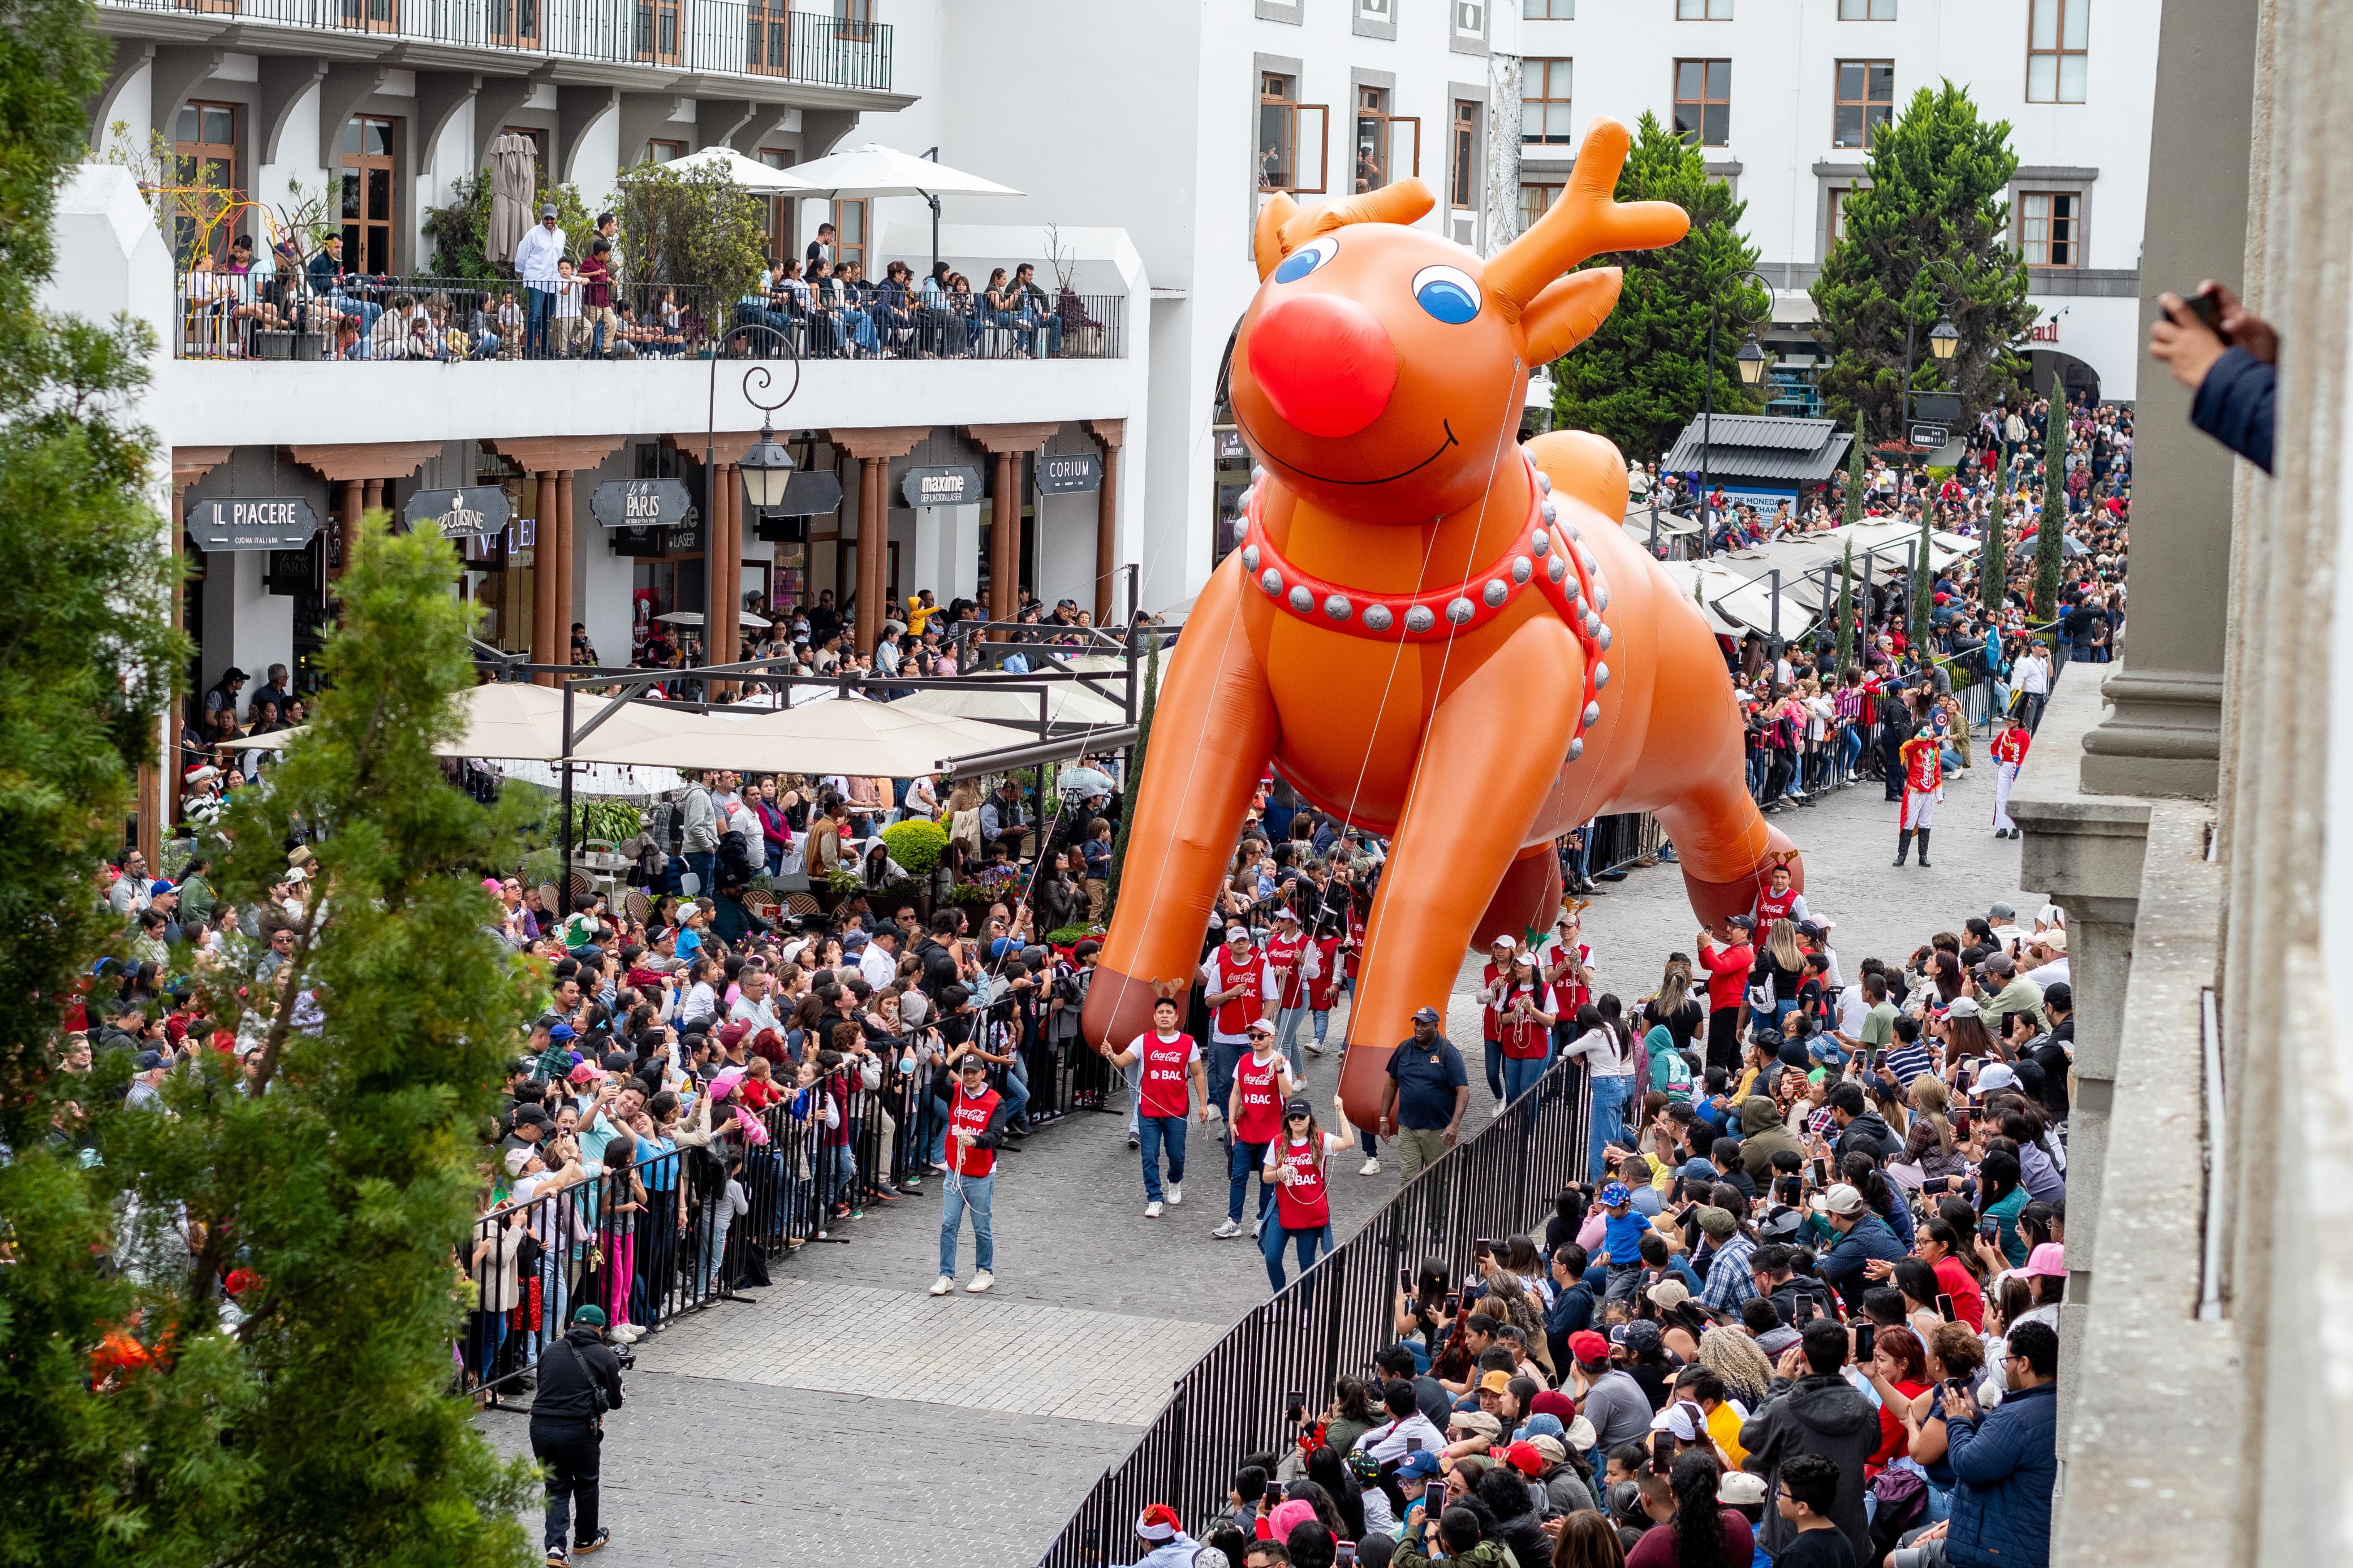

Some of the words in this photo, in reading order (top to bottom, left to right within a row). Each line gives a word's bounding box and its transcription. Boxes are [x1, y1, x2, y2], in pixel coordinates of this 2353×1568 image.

[1050, 461, 1089, 477] CORIUM
[921, 470, 964, 493] maxime
[626, 495, 660, 517] PARIS
[213, 503, 226, 524] IL
[233, 503, 296, 524] PIACERE
[447, 509, 484, 530] CUISINE
[1761, 903, 1786, 914] Coca-Cola
[1269, 948, 1295, 958] Coca-Cola
[1227, 973, 1257, 984] Coca-Cola
[1150, 1049, 1182, 1063] Coca-Cola
[1162, 1070, 1181, 1081] BAC
[1244, 1073, 1270, 1086] Coca-Cola
[1251, 1094, 1271, 1104] BAC
[954, 1105, 987, 1122] Coca-Cola
[1283, 1153, 1313, 1166] Coca-Cola
[1295, 1173, 1317, 1186] BAC
